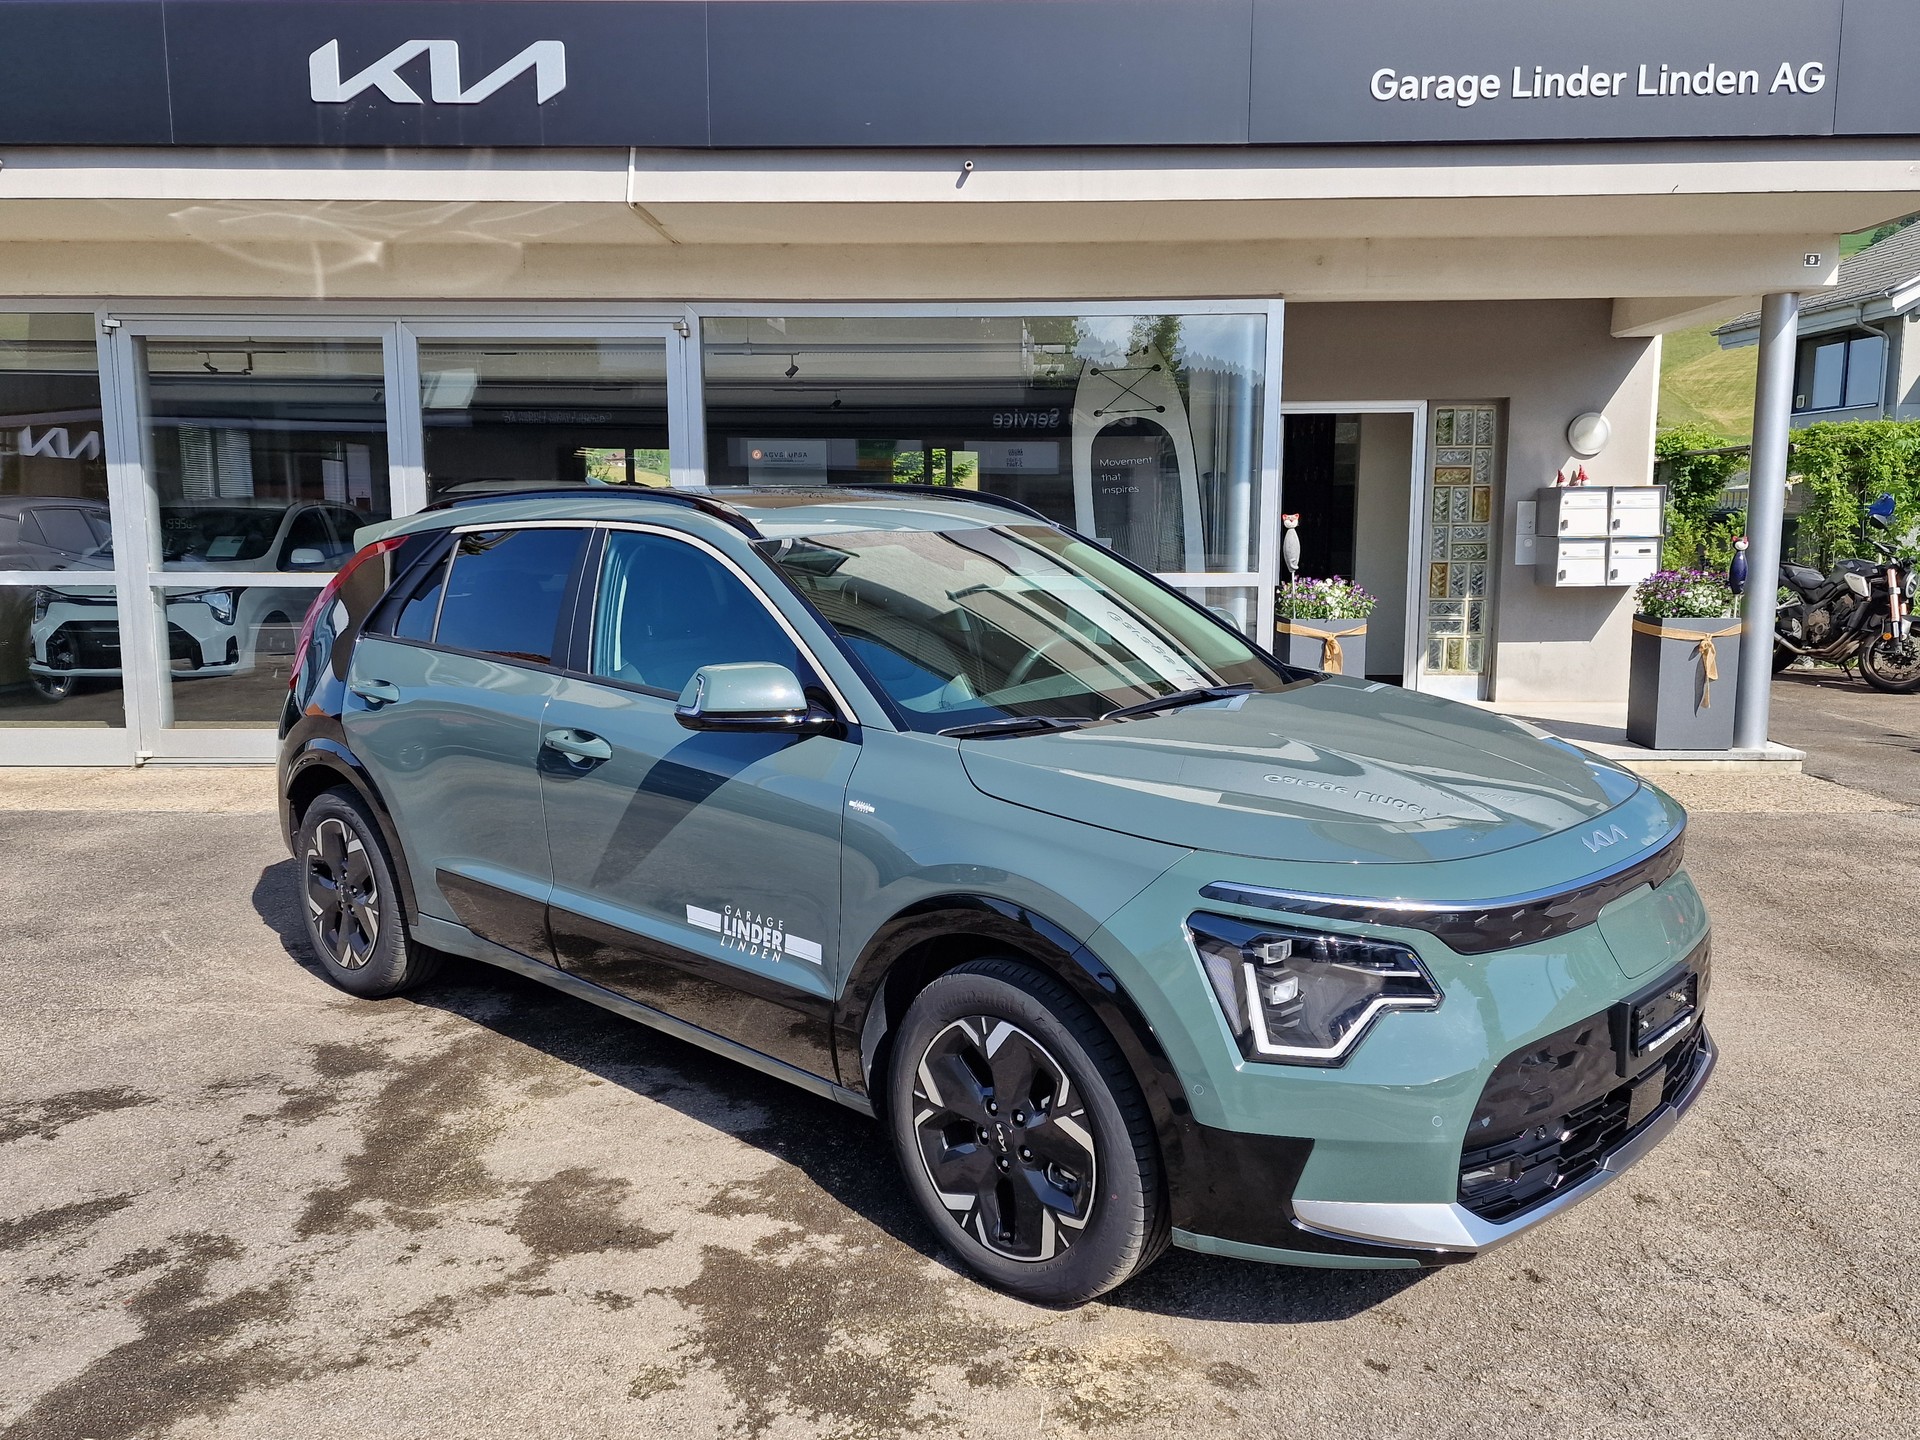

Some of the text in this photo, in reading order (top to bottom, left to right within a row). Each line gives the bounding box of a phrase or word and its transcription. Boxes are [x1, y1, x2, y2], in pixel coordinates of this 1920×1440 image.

[309, 38, 566, 105] KIA
[1370, 61, 1826, 107] Garage Linder Linden AG
[1809, 255, 1816, 264] 9
[18, 425, 100, 460] KIA
[1099, 456, 1152, 467] Movement
[1101, 473, 1121, 481] that
[1102, 485, 1140, 495] inspires
[1581, 824, 1628, 853] KIA
[724, 905, 785, 931] GARAGE
[723, 915, 783, 952] LINDER
[720, 936, 782, 964] LINDEN
